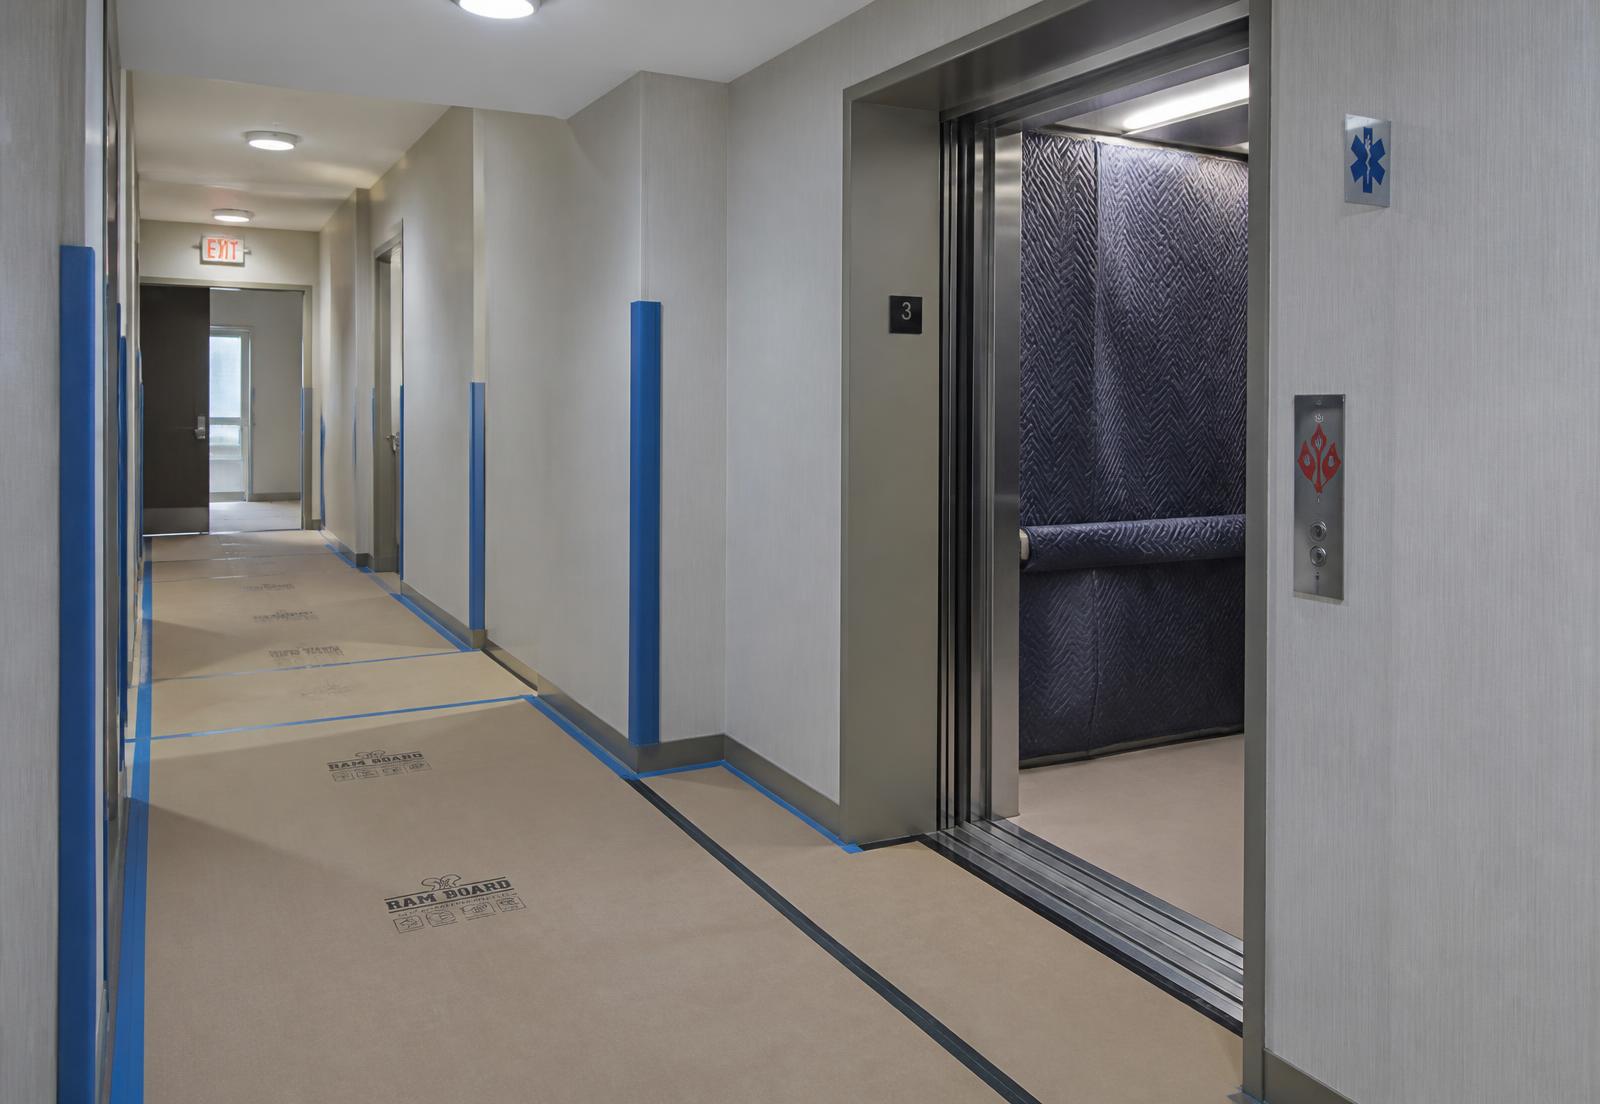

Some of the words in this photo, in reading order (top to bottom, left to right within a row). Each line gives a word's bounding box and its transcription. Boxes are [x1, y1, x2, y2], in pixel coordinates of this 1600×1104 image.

[207, 238, 239, 260] EXIT
[901, 301, 912, 320] 3
[385, 893, 437, 911] RAM
[442, 879, 511, 898] BOARD
